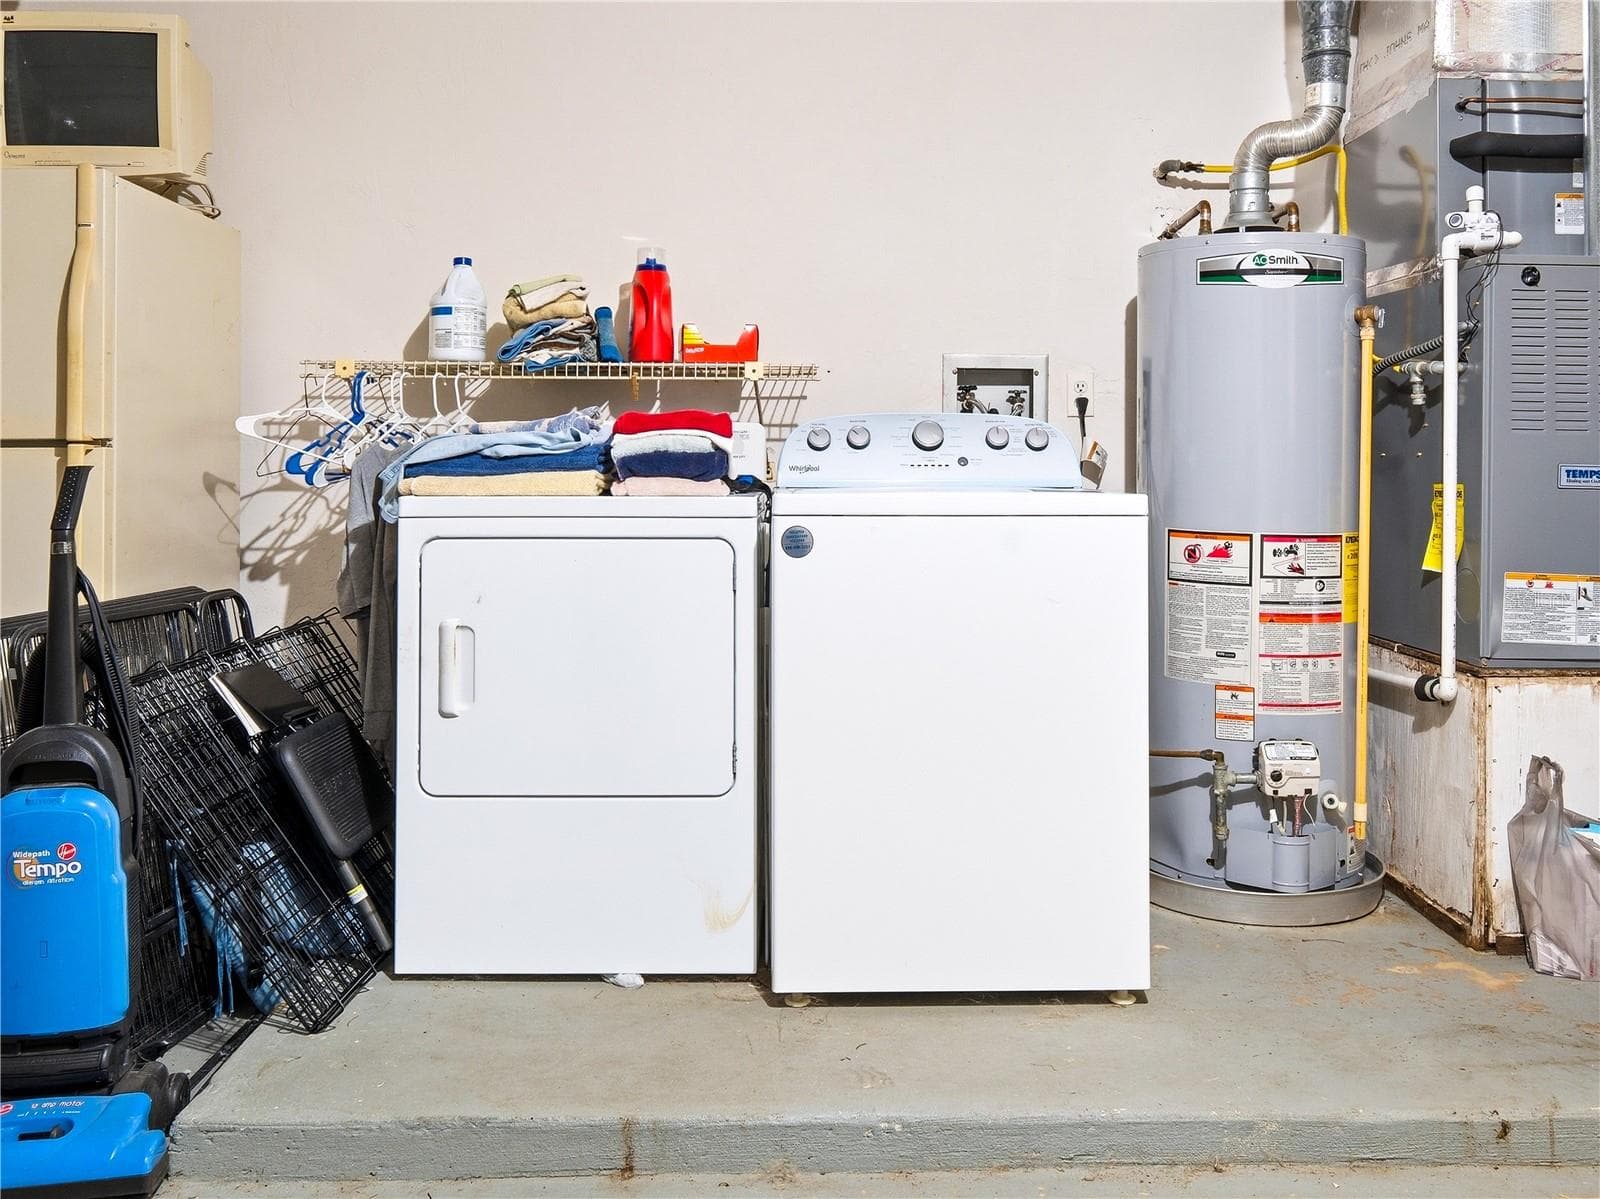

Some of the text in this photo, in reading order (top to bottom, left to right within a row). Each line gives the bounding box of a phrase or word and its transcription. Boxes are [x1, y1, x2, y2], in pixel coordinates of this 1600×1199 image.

[789, 464, 820, 474] Whirlpool
[12, 849, 51, 859] Widepath
[13, 859, 82, 878] Tempo
